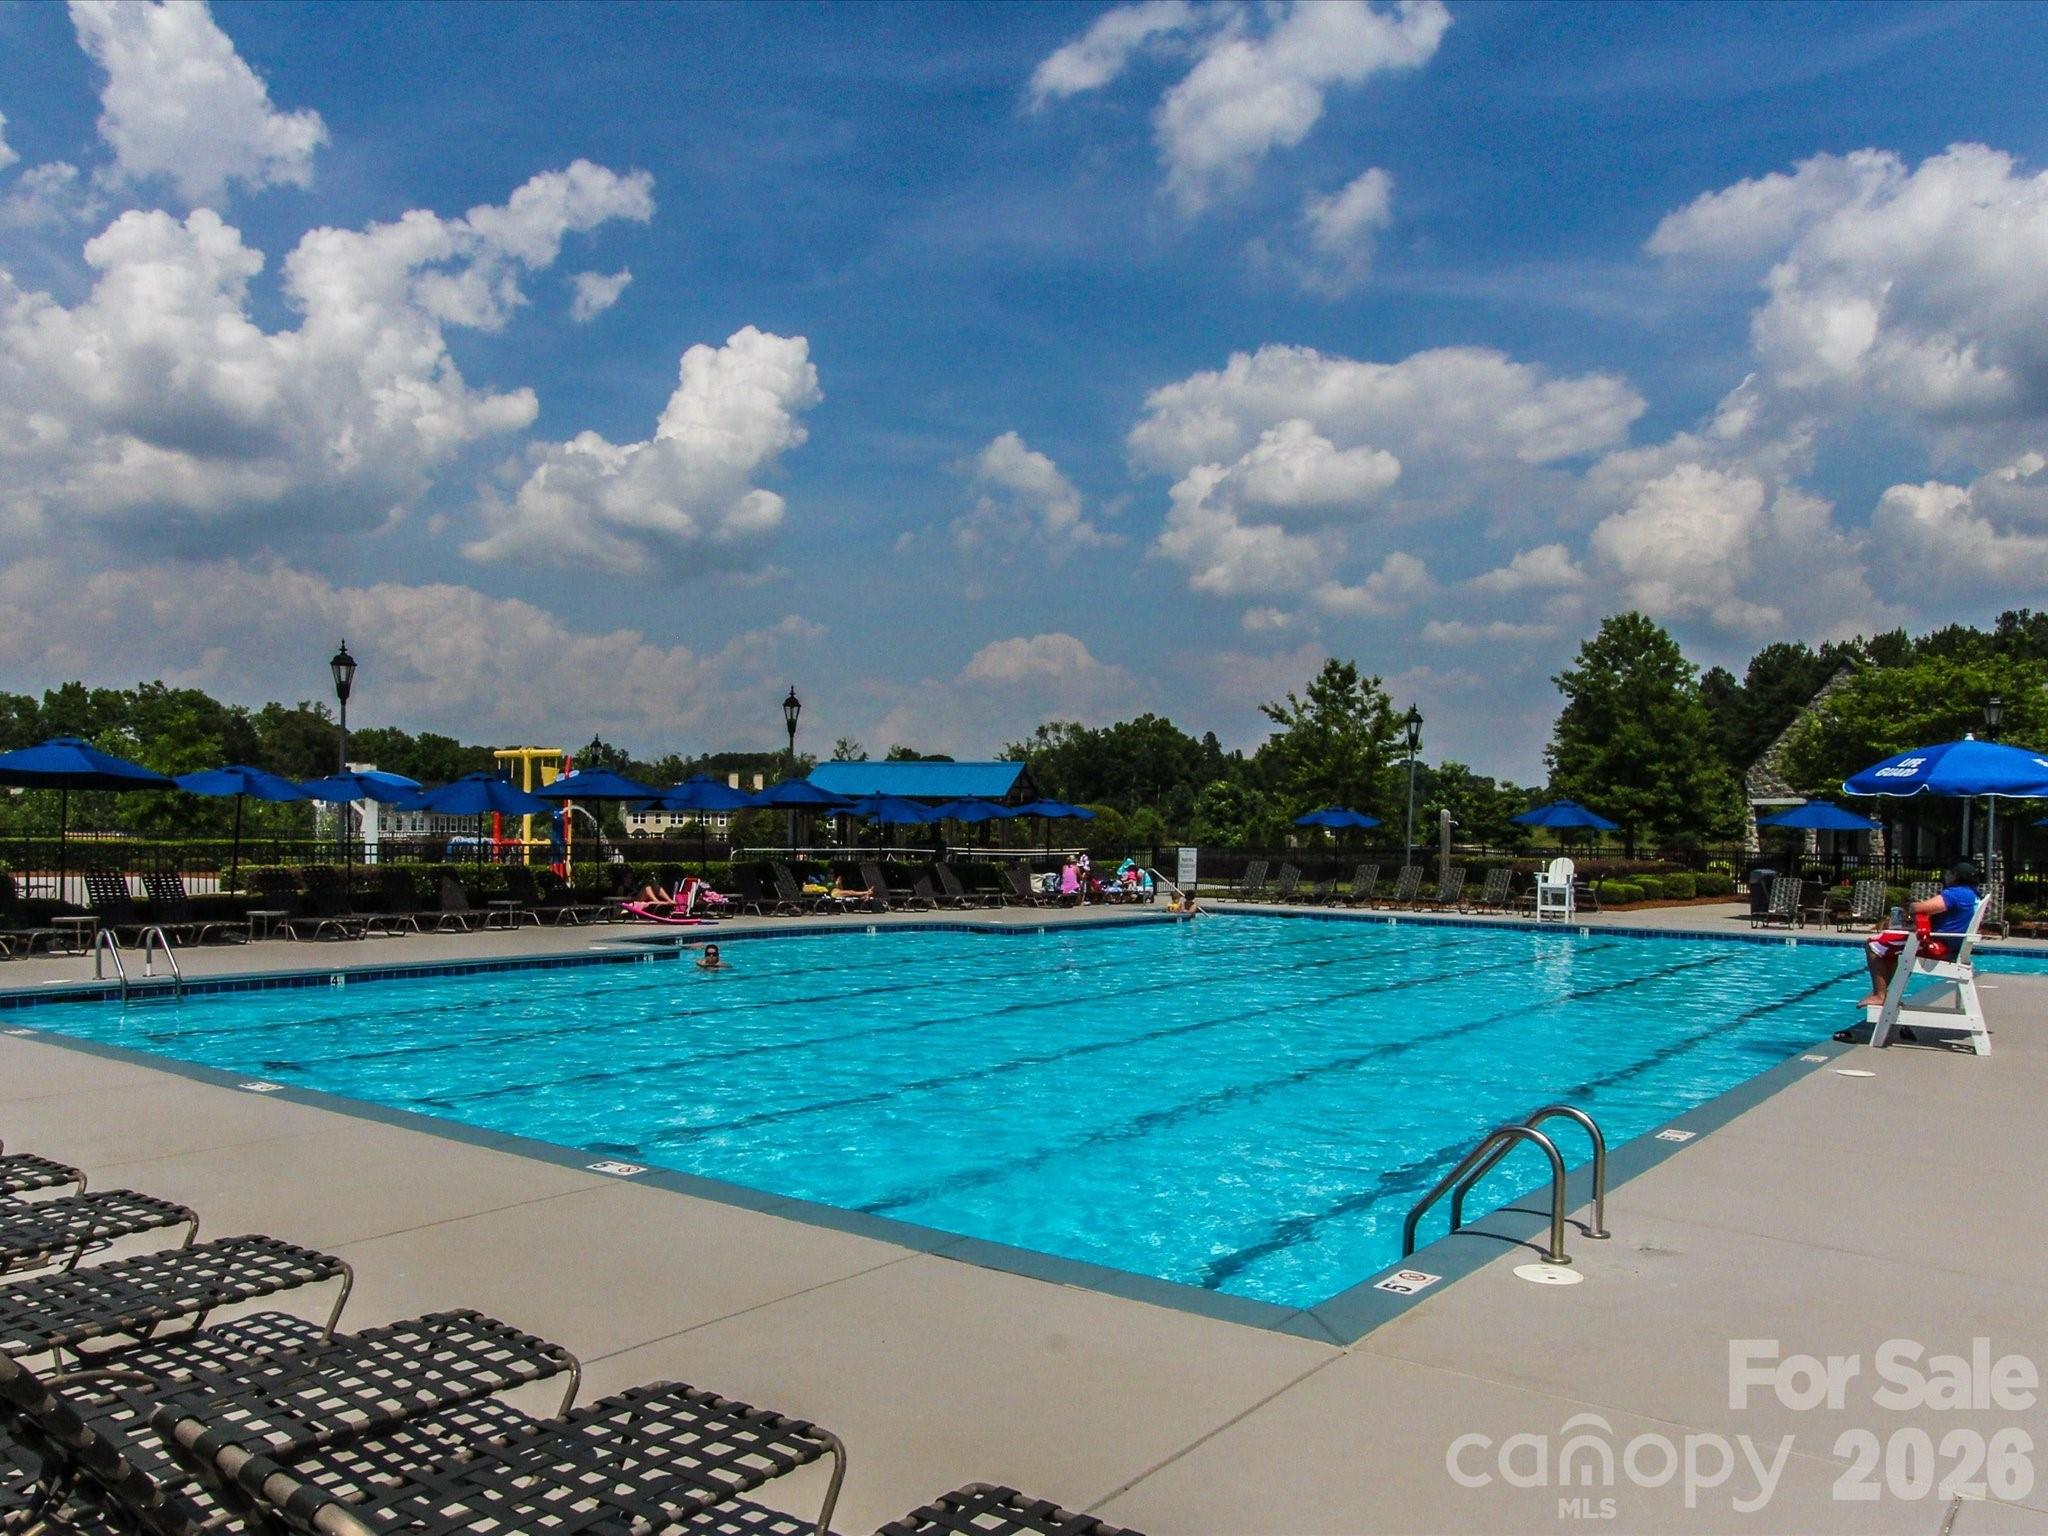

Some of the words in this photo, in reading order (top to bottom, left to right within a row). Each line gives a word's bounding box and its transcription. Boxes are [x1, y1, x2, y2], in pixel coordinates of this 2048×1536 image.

[1897, 758, 1927, 767] LIFE
[1875, 767, 1919, 777] GUARD
[1382, 1283, 1413, 1292] 5
